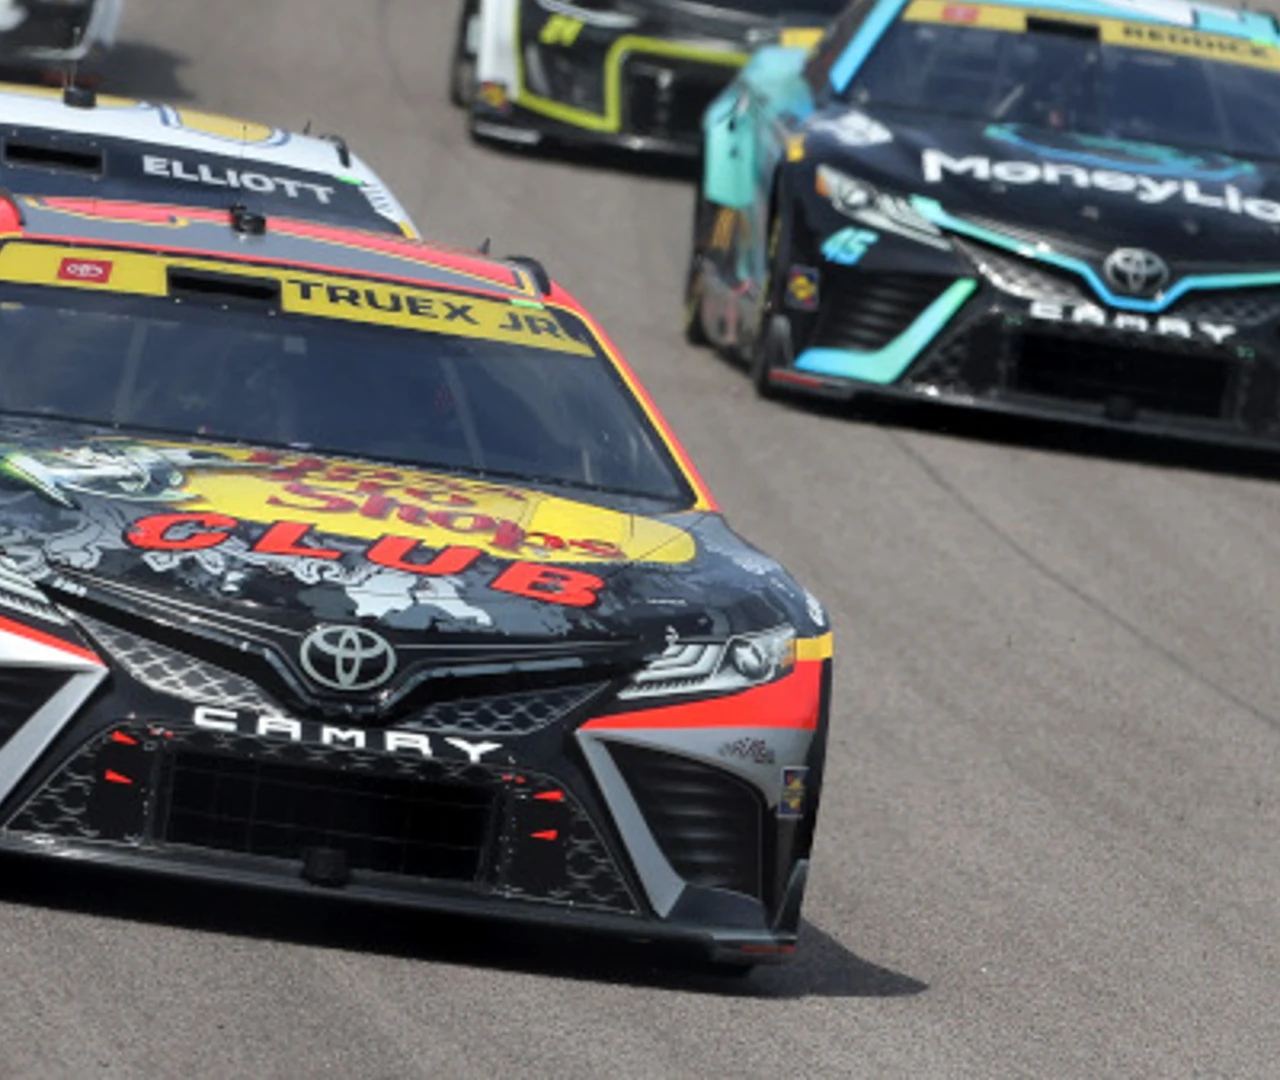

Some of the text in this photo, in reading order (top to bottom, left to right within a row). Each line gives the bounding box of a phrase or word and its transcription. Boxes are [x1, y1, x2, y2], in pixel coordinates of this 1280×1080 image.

[142, 153, 336, 205] ELLIOTT
[821, 226, 879, 265] 45
[287, 278, 479, 326] TRUEX
[1030, 300, 1237, 344] CAMRY
[265, 482, 628, 561] Shops
[126, 512, 606, 608] CLUB
[193, 706, 503, 764] CAMRY
